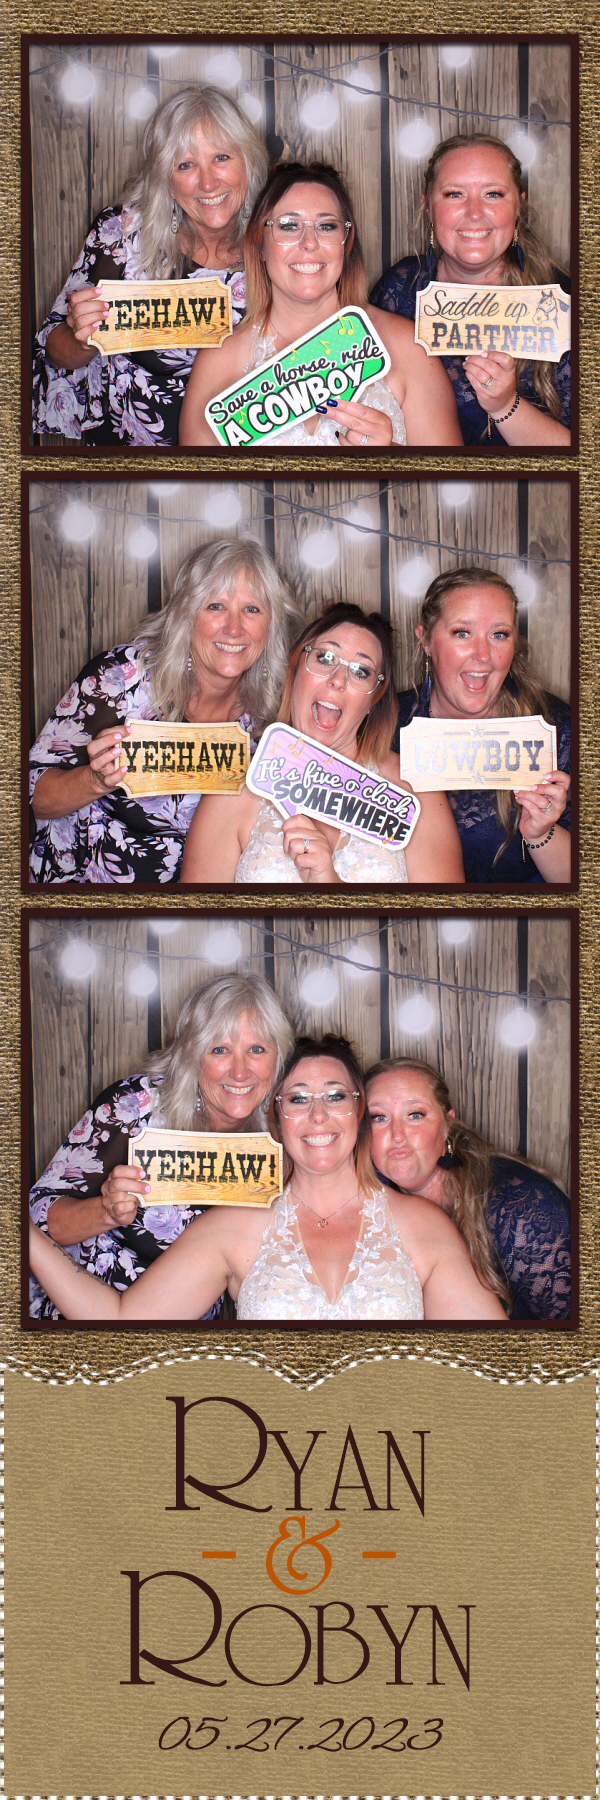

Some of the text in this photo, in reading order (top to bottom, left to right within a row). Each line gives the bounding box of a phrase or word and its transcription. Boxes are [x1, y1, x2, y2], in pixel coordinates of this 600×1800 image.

[424, 290, 530, 324] Saddle up
[431, 322, 558, 354] PARTNER
[208, 337, 383, 424] Save a horse, ride
[223, 361, 365, 446] A COWBOY
[121, 740, 245, 774] YEEHAW!
[414, 739, 545, 773] COWBOY
[256, 757, 413, 819] It's five o'clock
[273, 779, 411, 842] SOMEWHERE
[134, 1149, 277, 1186] YEEHAW!
